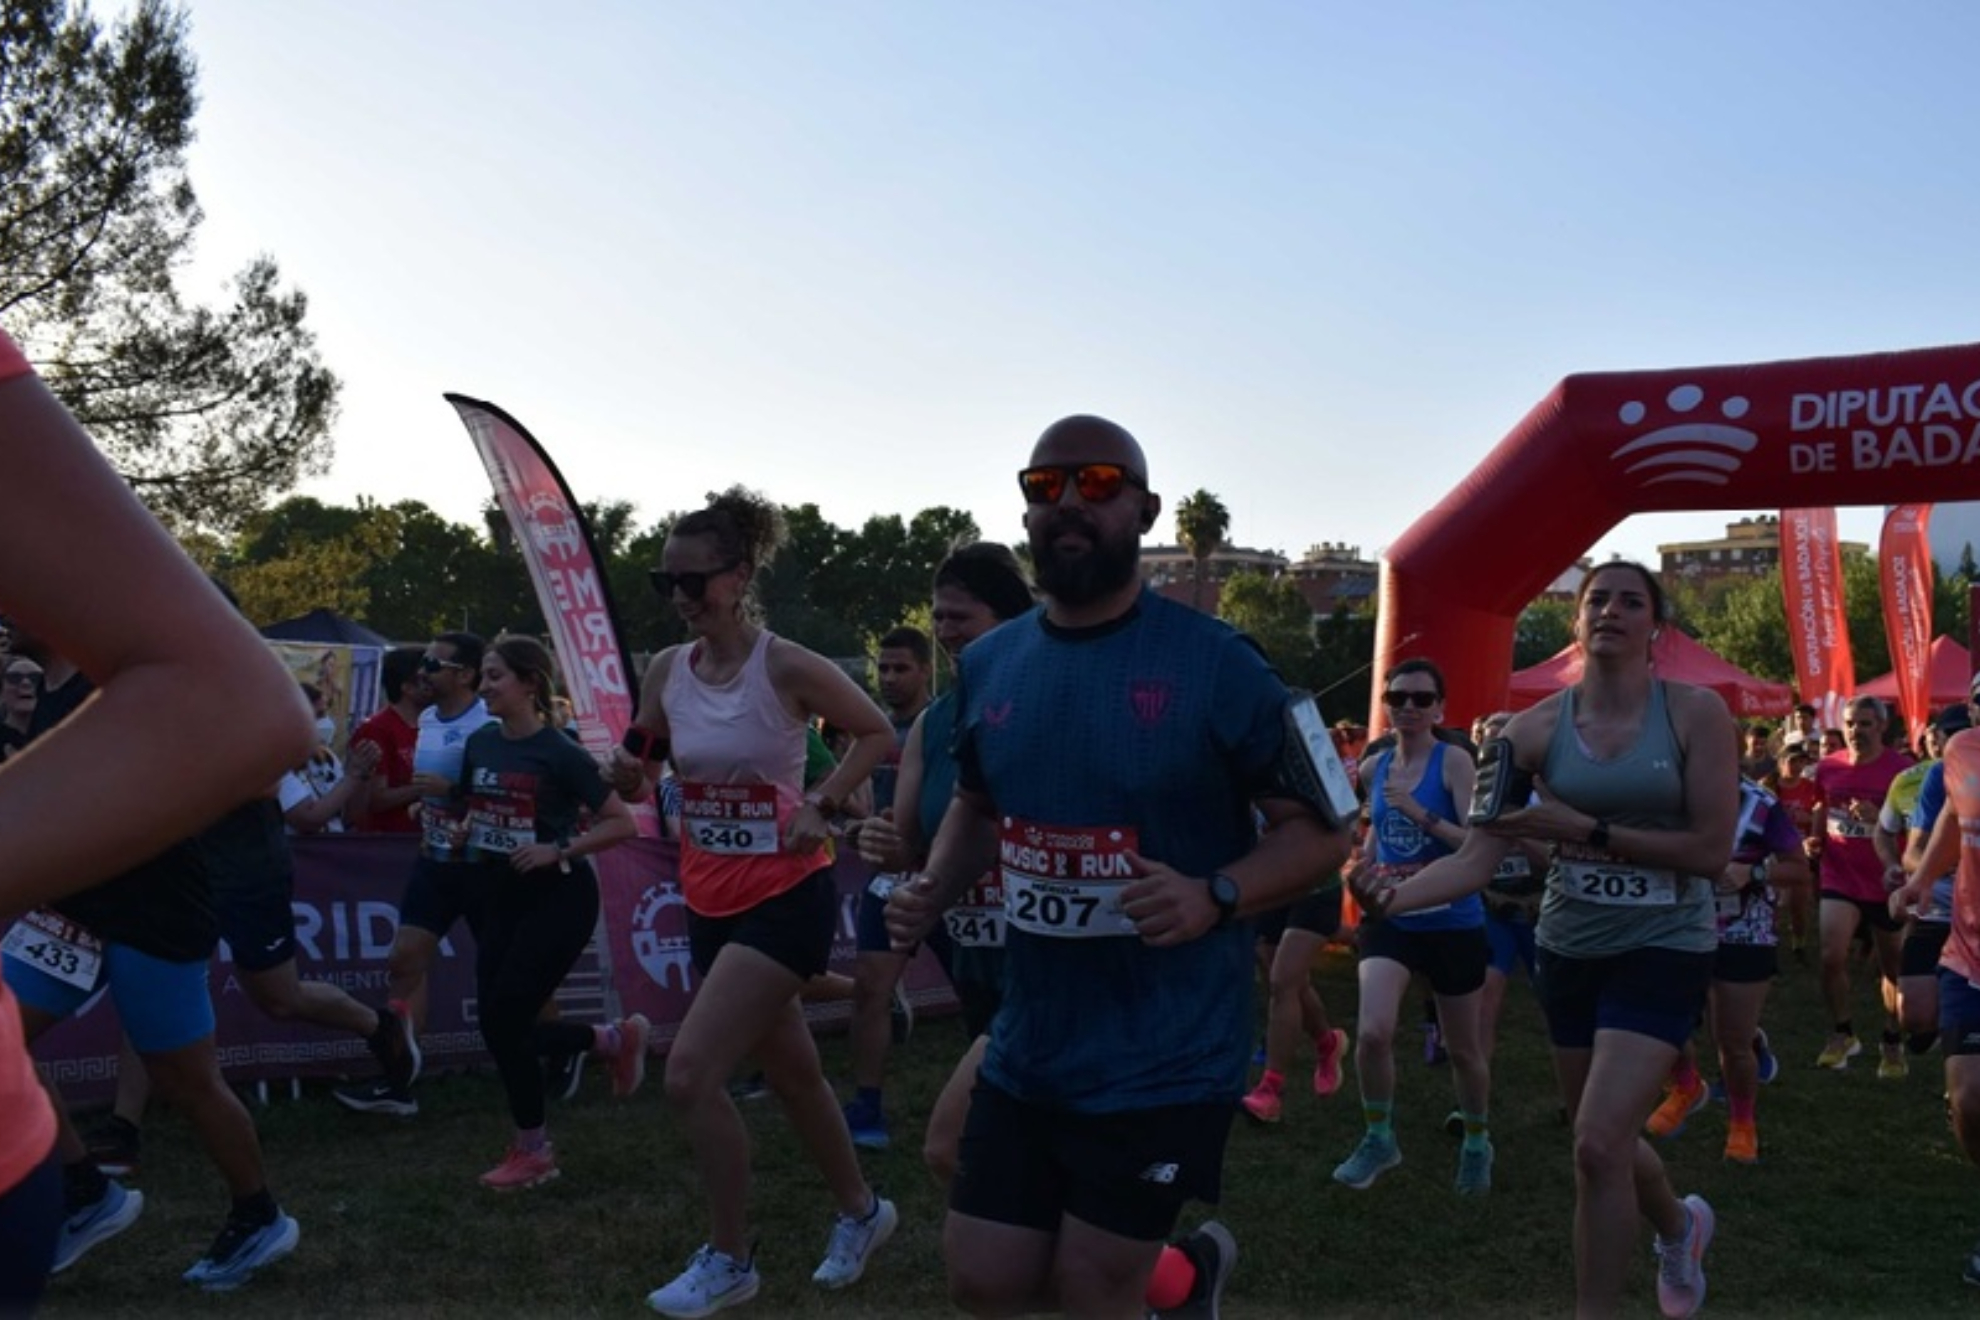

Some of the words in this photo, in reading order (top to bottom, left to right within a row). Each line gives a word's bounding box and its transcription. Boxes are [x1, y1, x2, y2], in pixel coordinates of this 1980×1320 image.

[1789, 443, 1836, 473] DE
[740, 801, 774, 819] RUN
[700, 827, 753, 848] 240
[1001, 840, 1049, 875] MUSIC
[1081, 853, 1133, 878] RUN
[1581, 873, 1649, 897] 203
[1016, 889, 1100, 927] 207
[947, 915, 998, 942] 241
[25, 940, 79, 974] 433
